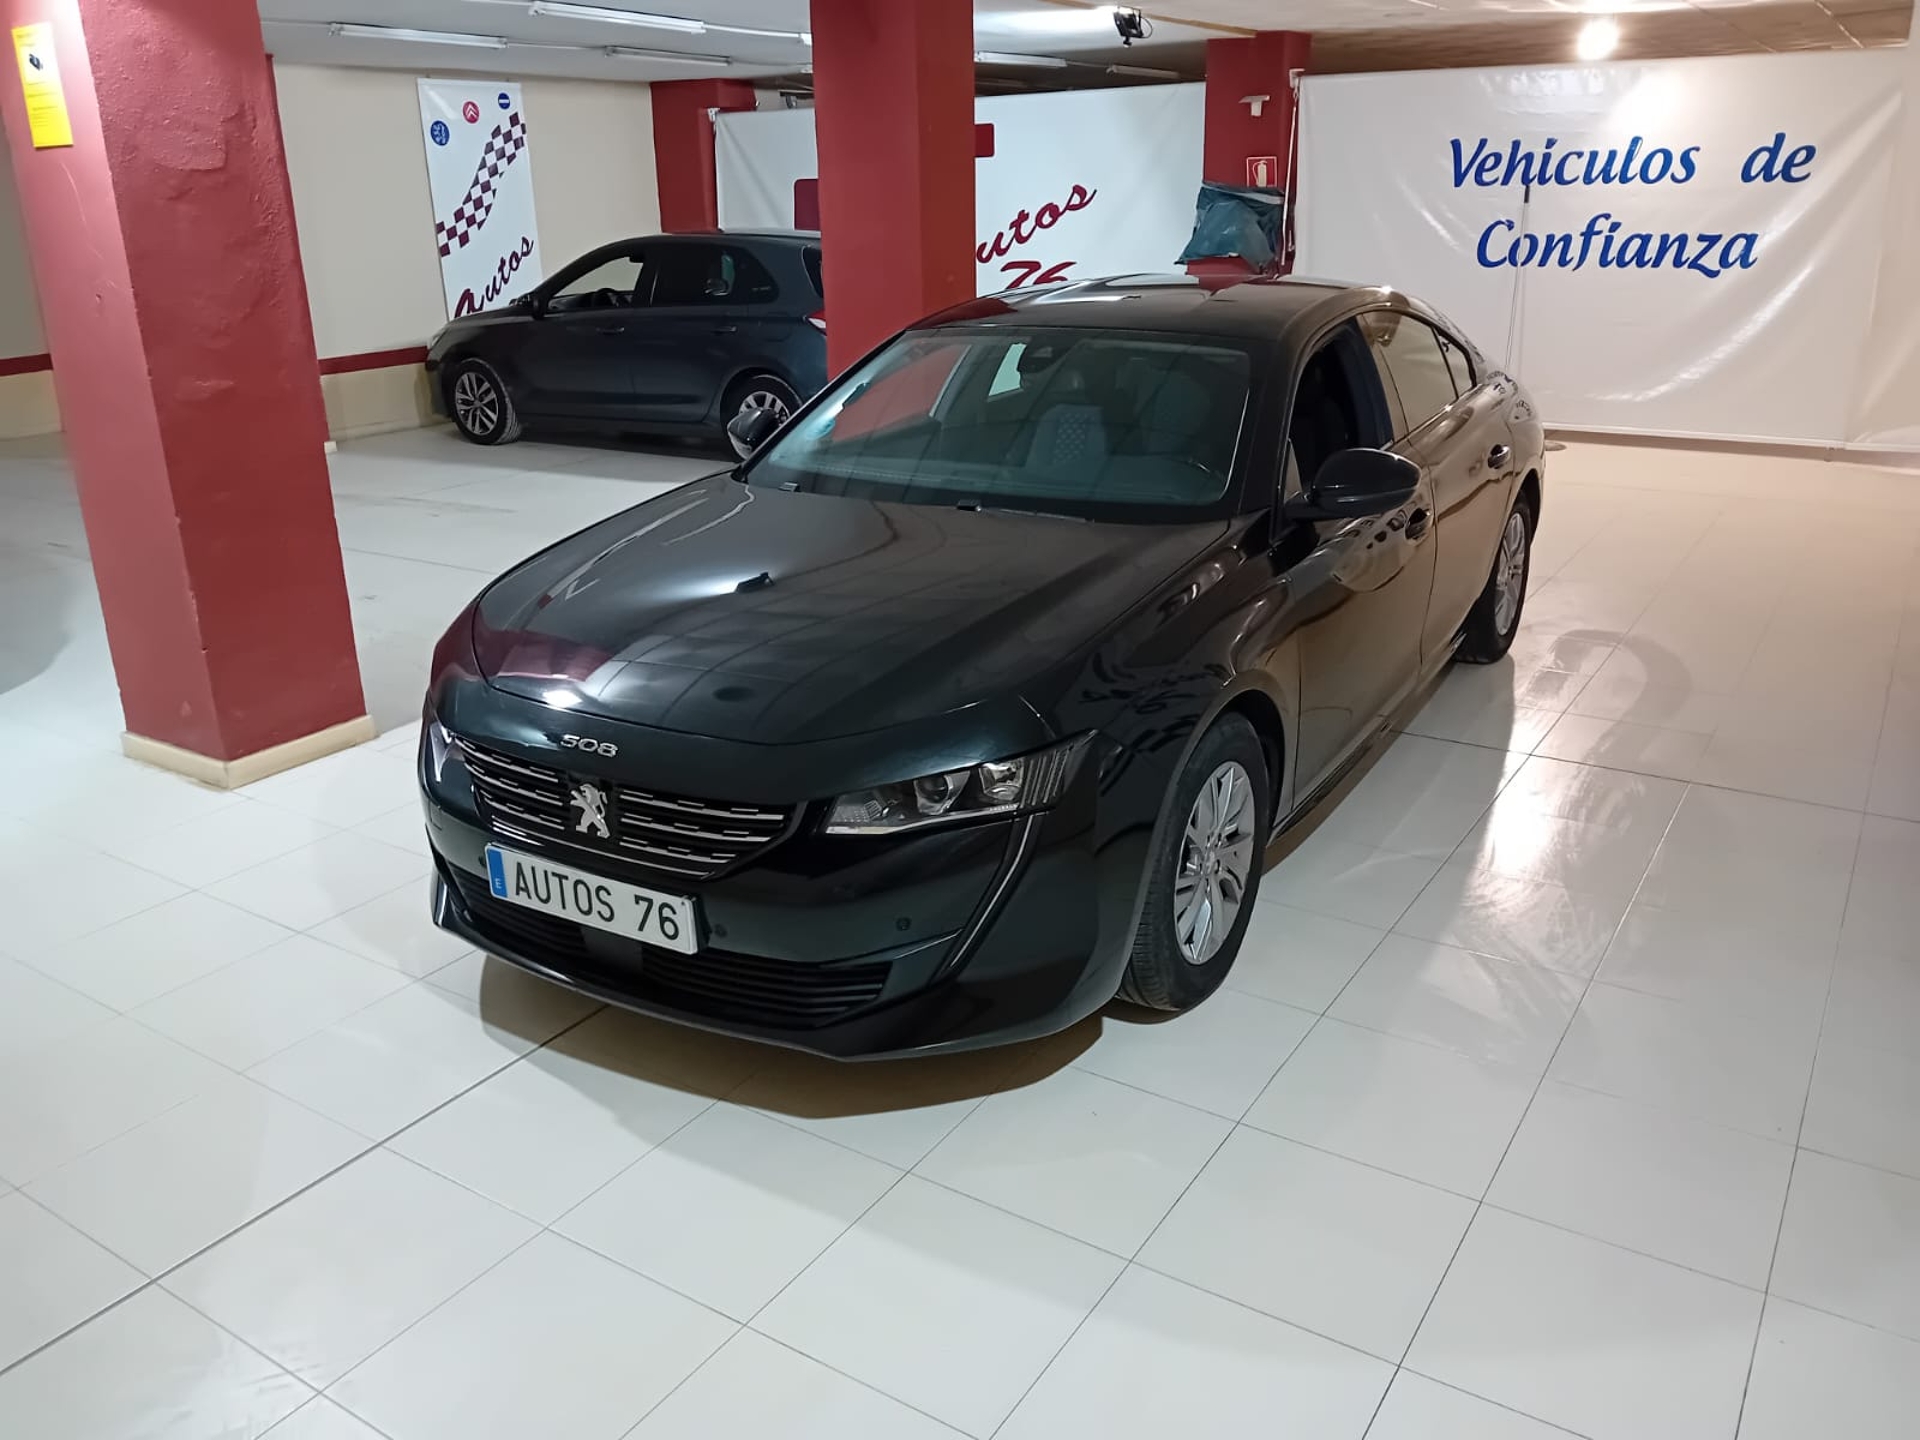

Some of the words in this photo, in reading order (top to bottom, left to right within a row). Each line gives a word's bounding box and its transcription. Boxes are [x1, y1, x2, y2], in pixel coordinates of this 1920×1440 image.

[1451, 136, 1700, 188] Vehiculos
[1741, 132, 1816, 183] de
[976, 184, 1097, 264] utos
[1476, 212, 1758, 278] Confianza
[453, 236, 534, 318] Autos
[560, 734, 618, 758] 508
[515, 862, 615, 923] AUTOS
[634, 894, 679, 940] 76
